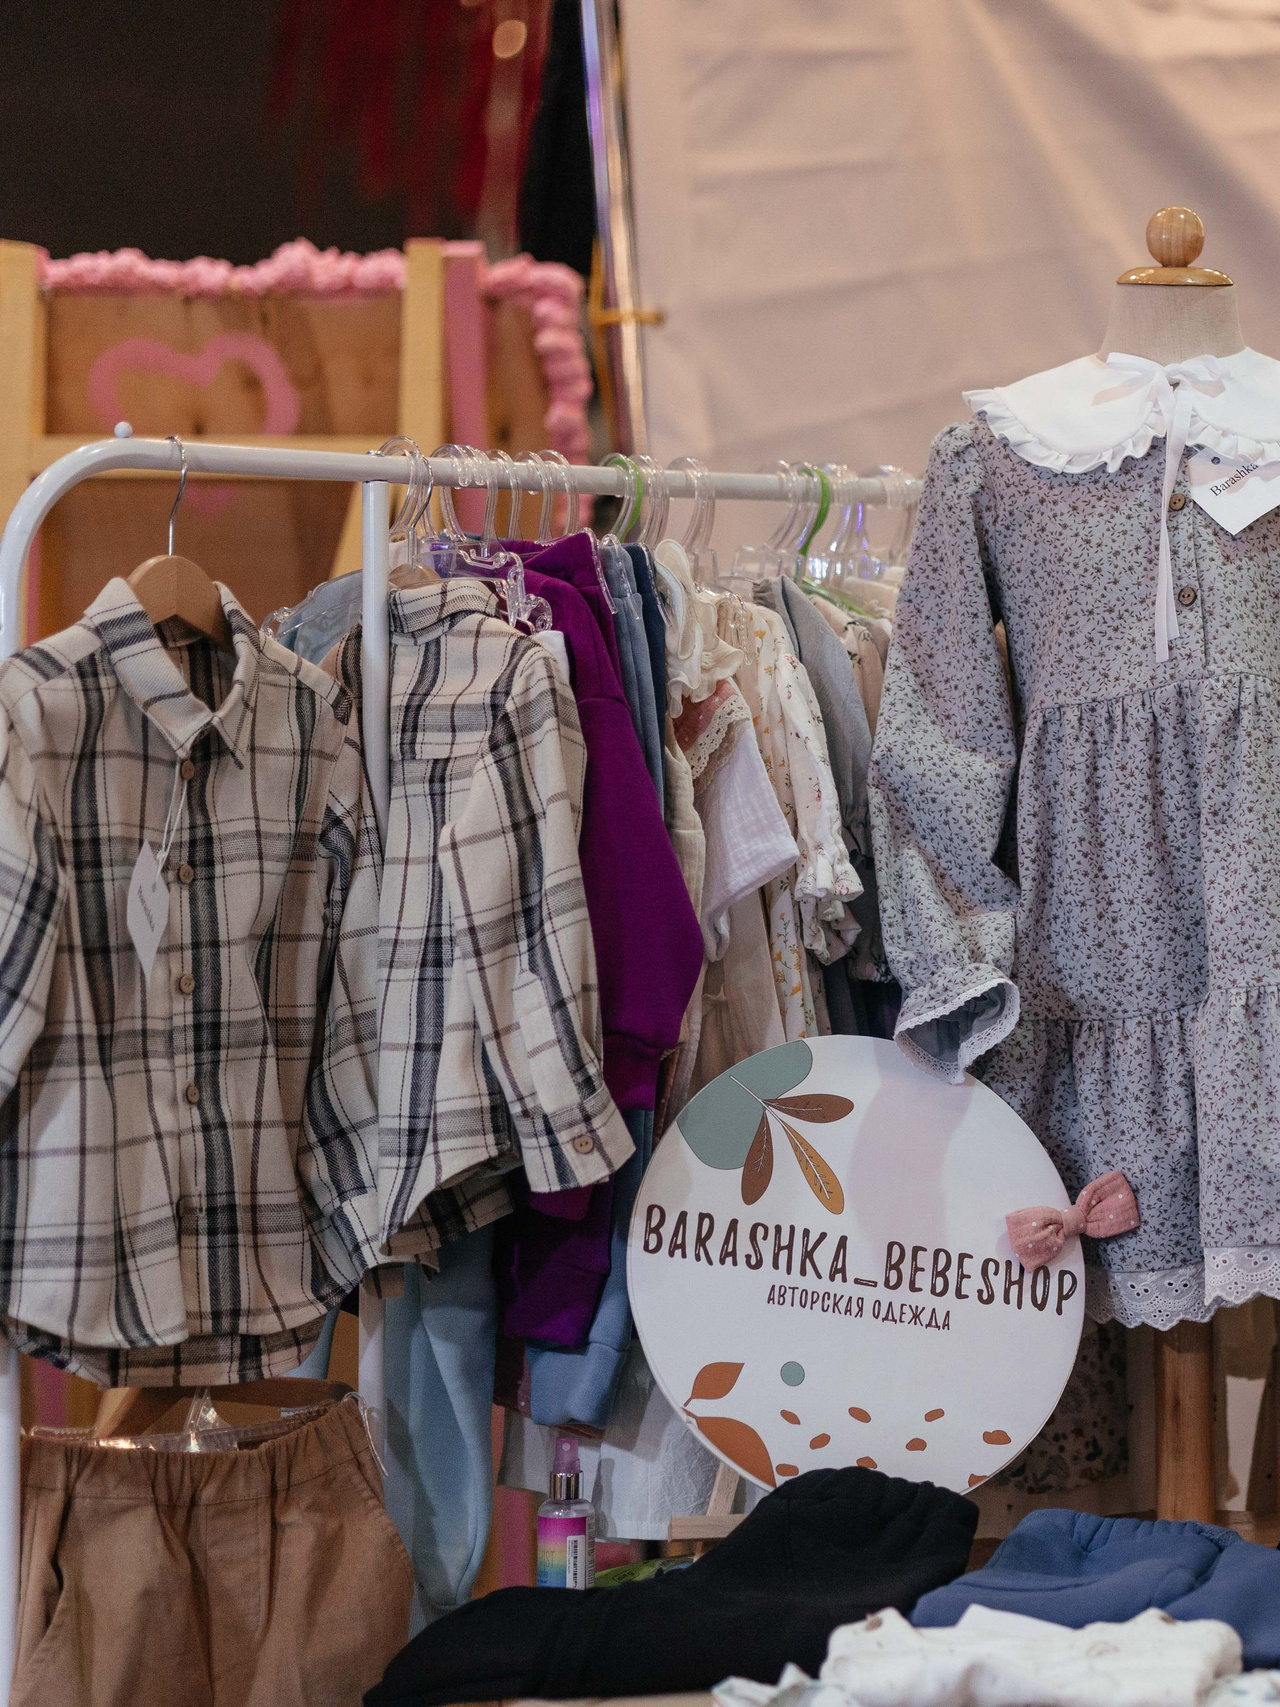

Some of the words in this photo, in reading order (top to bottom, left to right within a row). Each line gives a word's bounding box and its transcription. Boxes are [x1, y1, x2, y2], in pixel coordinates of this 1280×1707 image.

[1209, 463, 1259, 497] Barashka
[643, 1203, 1078, 1316] BARASHKA_BEBESHOP
[767, 1284, 864, 1319] АВТОРСКАЯ
[872, 1299, 951, 1331] ОДЕЖДА
